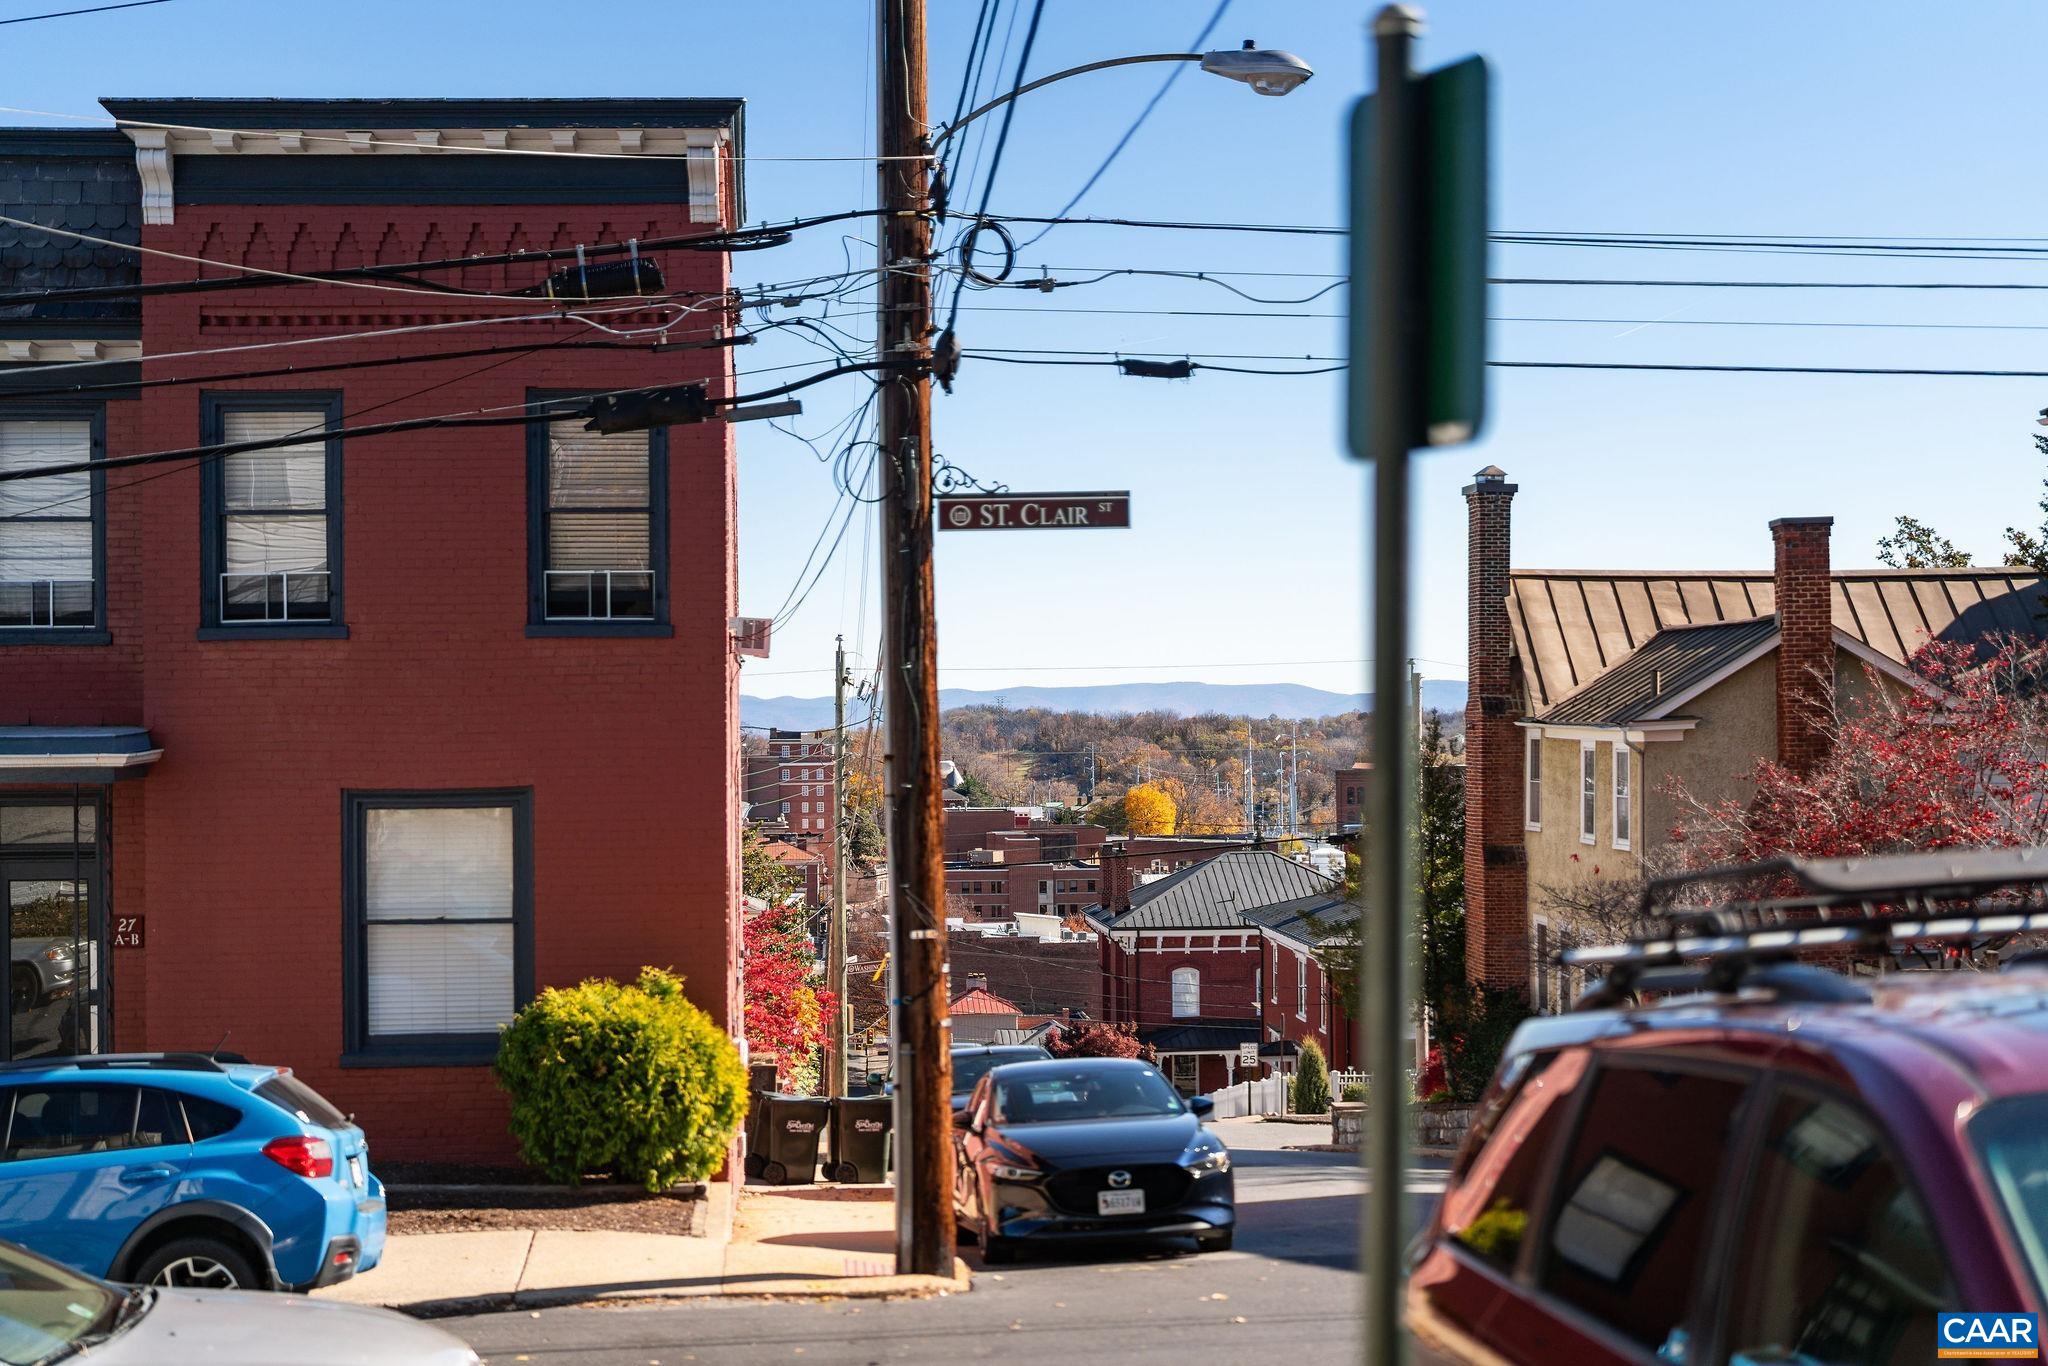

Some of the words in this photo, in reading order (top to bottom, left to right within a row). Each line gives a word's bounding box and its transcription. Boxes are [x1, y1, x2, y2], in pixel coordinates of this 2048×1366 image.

[980, 503, 1013, 526] ST.
[1020, 503, 1089, 526] CLAIR
[1098, 502, 1113, 513] ST
[118, 918, 137, 932] 27
[114, 933, 140, 945] A-B
[1242, 1055, 1256, 1064] 25
